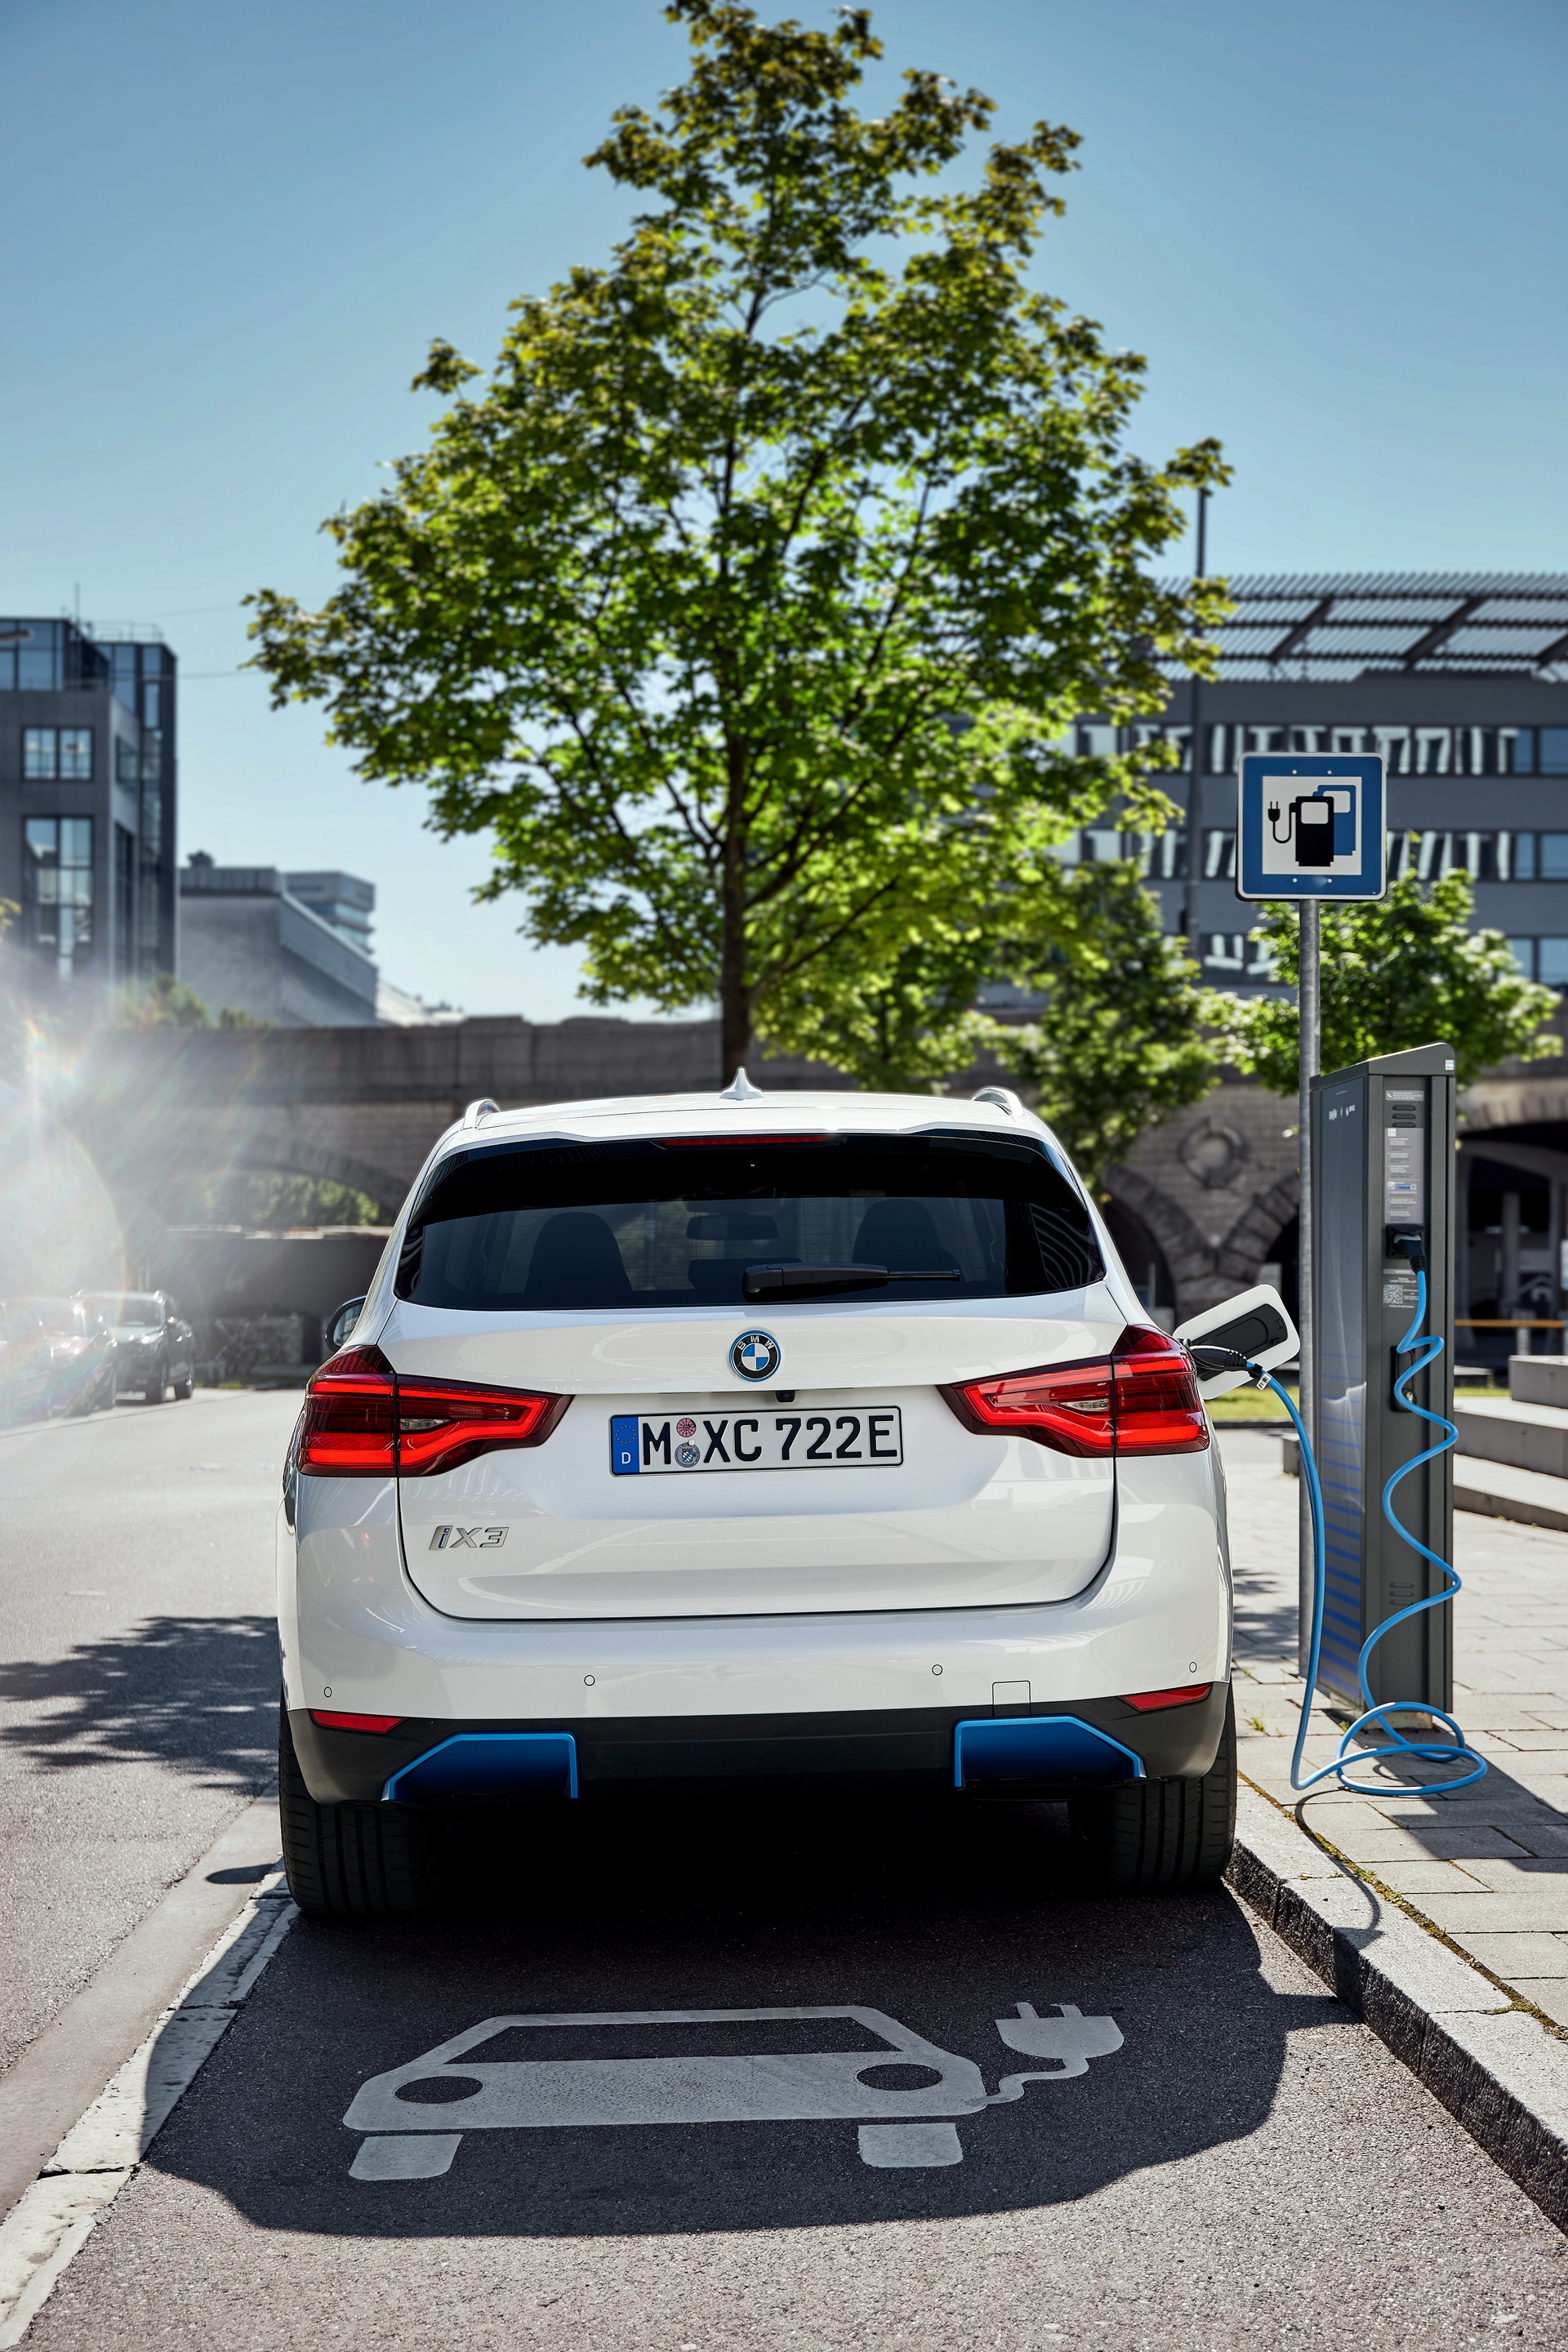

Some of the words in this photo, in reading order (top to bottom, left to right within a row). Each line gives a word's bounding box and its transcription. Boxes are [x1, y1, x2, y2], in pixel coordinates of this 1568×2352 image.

[737, 1335, 775, 1351] BMW
[642, 1422, 671, 1465] M
[702, 1419, 763, 1463] XC
[775, 1414, 898, 1461] 722E
[621, 1451, 631, 1464] D
[428, 1525, 510, 1551] iX3
